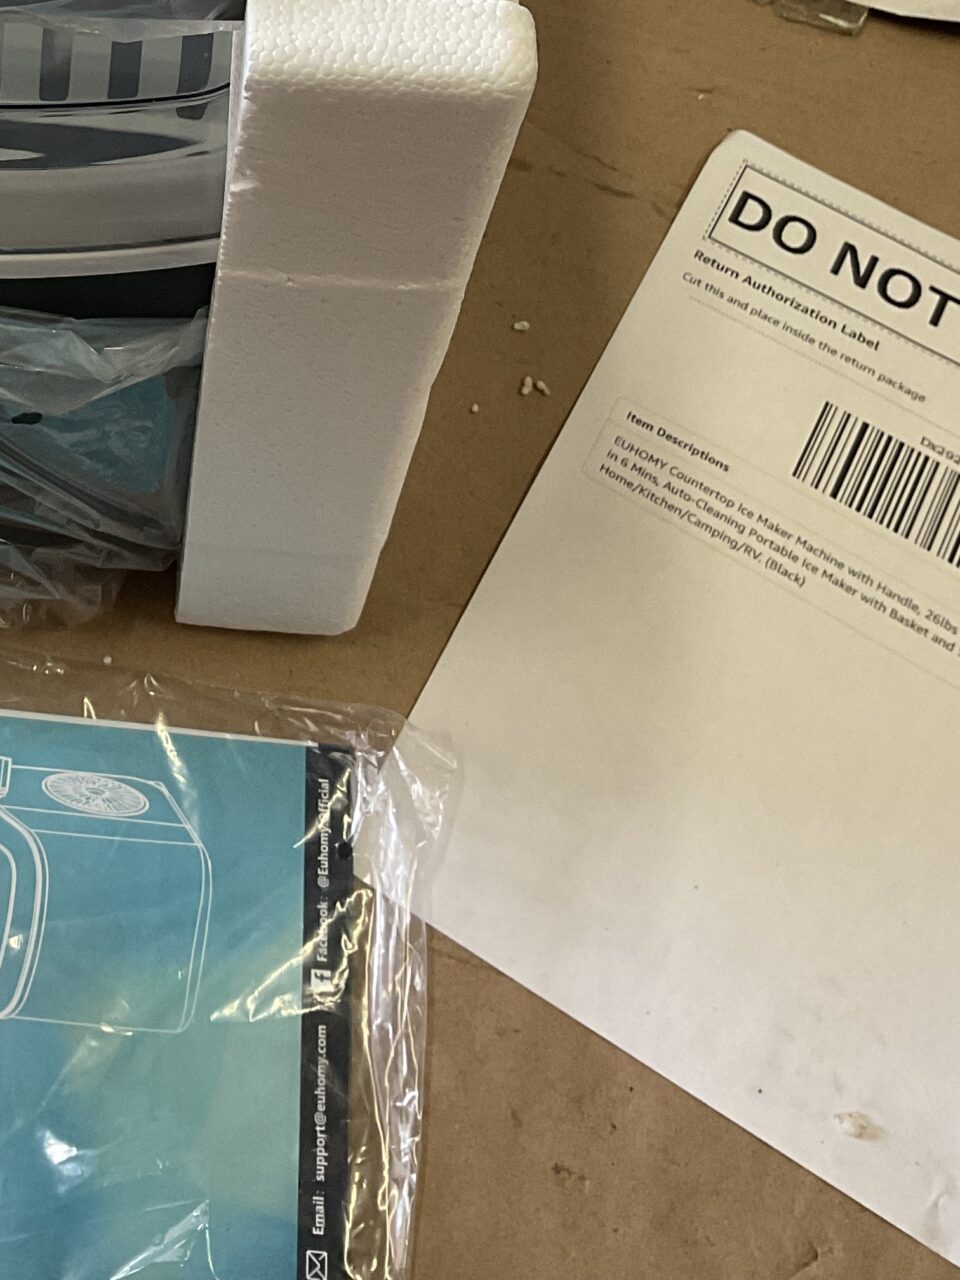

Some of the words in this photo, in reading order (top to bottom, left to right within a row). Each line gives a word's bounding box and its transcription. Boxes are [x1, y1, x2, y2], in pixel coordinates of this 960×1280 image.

[693, 249, 741, 280] Return
[741, 275, 838, 329] Authorization
[840, 324, 881, 352] Label
[728, 189, 817, 255] DO
[829, 241, 960, 329] NOT
[681, 271, 702, 288] Cut
[704, 281, 725, 300] this
[726, 295, 749, 313] and
[749, 307, 781, 329] place
[781, 321, 816, 346] inside
[818, 339, 838, 357] the
[839, 351, 877, 378] return
[877, 372, 927, 404] package
[626, 411, 654, 433] Item
[656, 422, 730, 473] Descriptions
[606, 448, 619, 462] in
[619, 455, 629, 467] 6
[662, 479, 747, 536] Auto-Cleaning
[748, 526, 800, 565] Portable
[801, 556, 820, 575] Ice
[820, 567, 860, 600] Maker
[860, 588, 888, 615] with
[888, 607, 929, 639] Basket
[930, 631, 958, 654] and
[613, 435, 668, 471] EUHOMY
[668, 465, 735, 510] Countertop
[737, 498, 755, 519] Ice
[756, 510, 796, 541] Maker
[795, 535, 846, 571] Machine
[847, 561, 875, 588] with
[875, 574, 921, 616] Handle,
[924, 607, 959, 636] 26lbs
[764, 556, 807, 589] (Black)
[313, 1023, 329, 1182] support@euhomy.com
[312, 1190, 326, 1236] Email:
